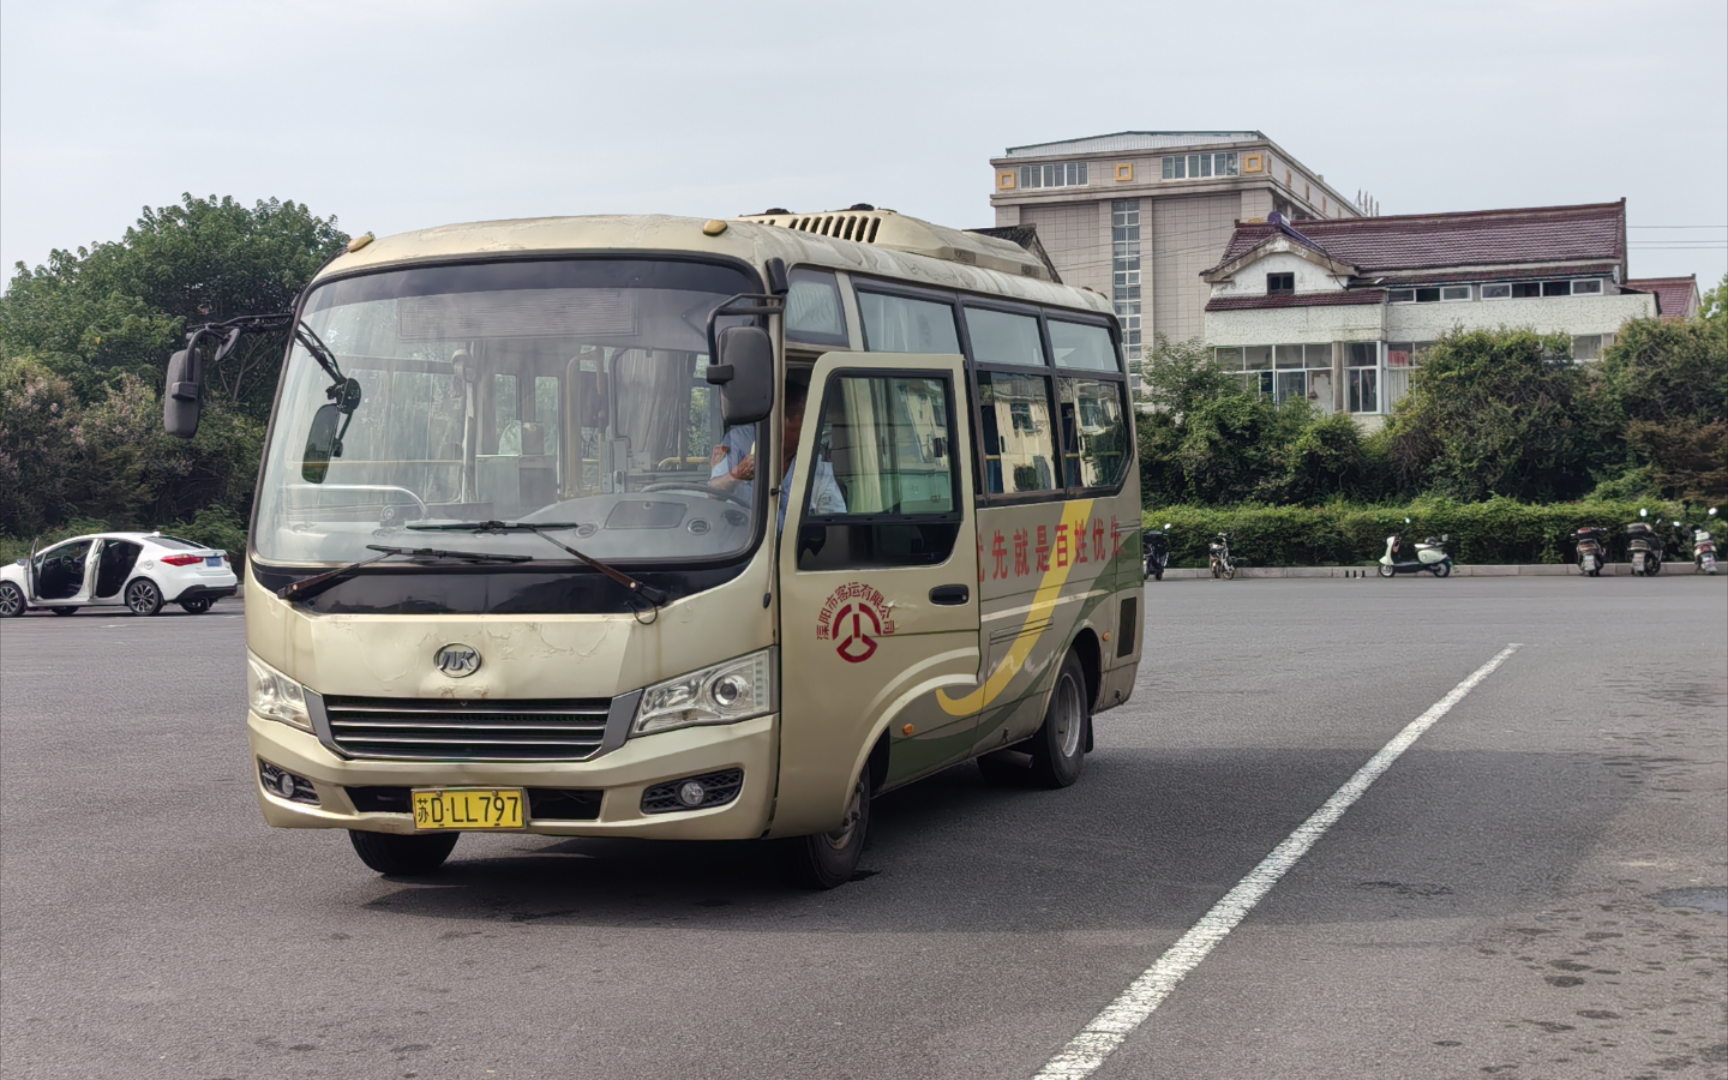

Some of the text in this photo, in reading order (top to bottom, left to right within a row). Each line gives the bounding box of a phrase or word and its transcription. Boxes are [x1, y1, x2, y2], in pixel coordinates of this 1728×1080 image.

[817, 582, 894, 640] 溧阳市客运有限公司
